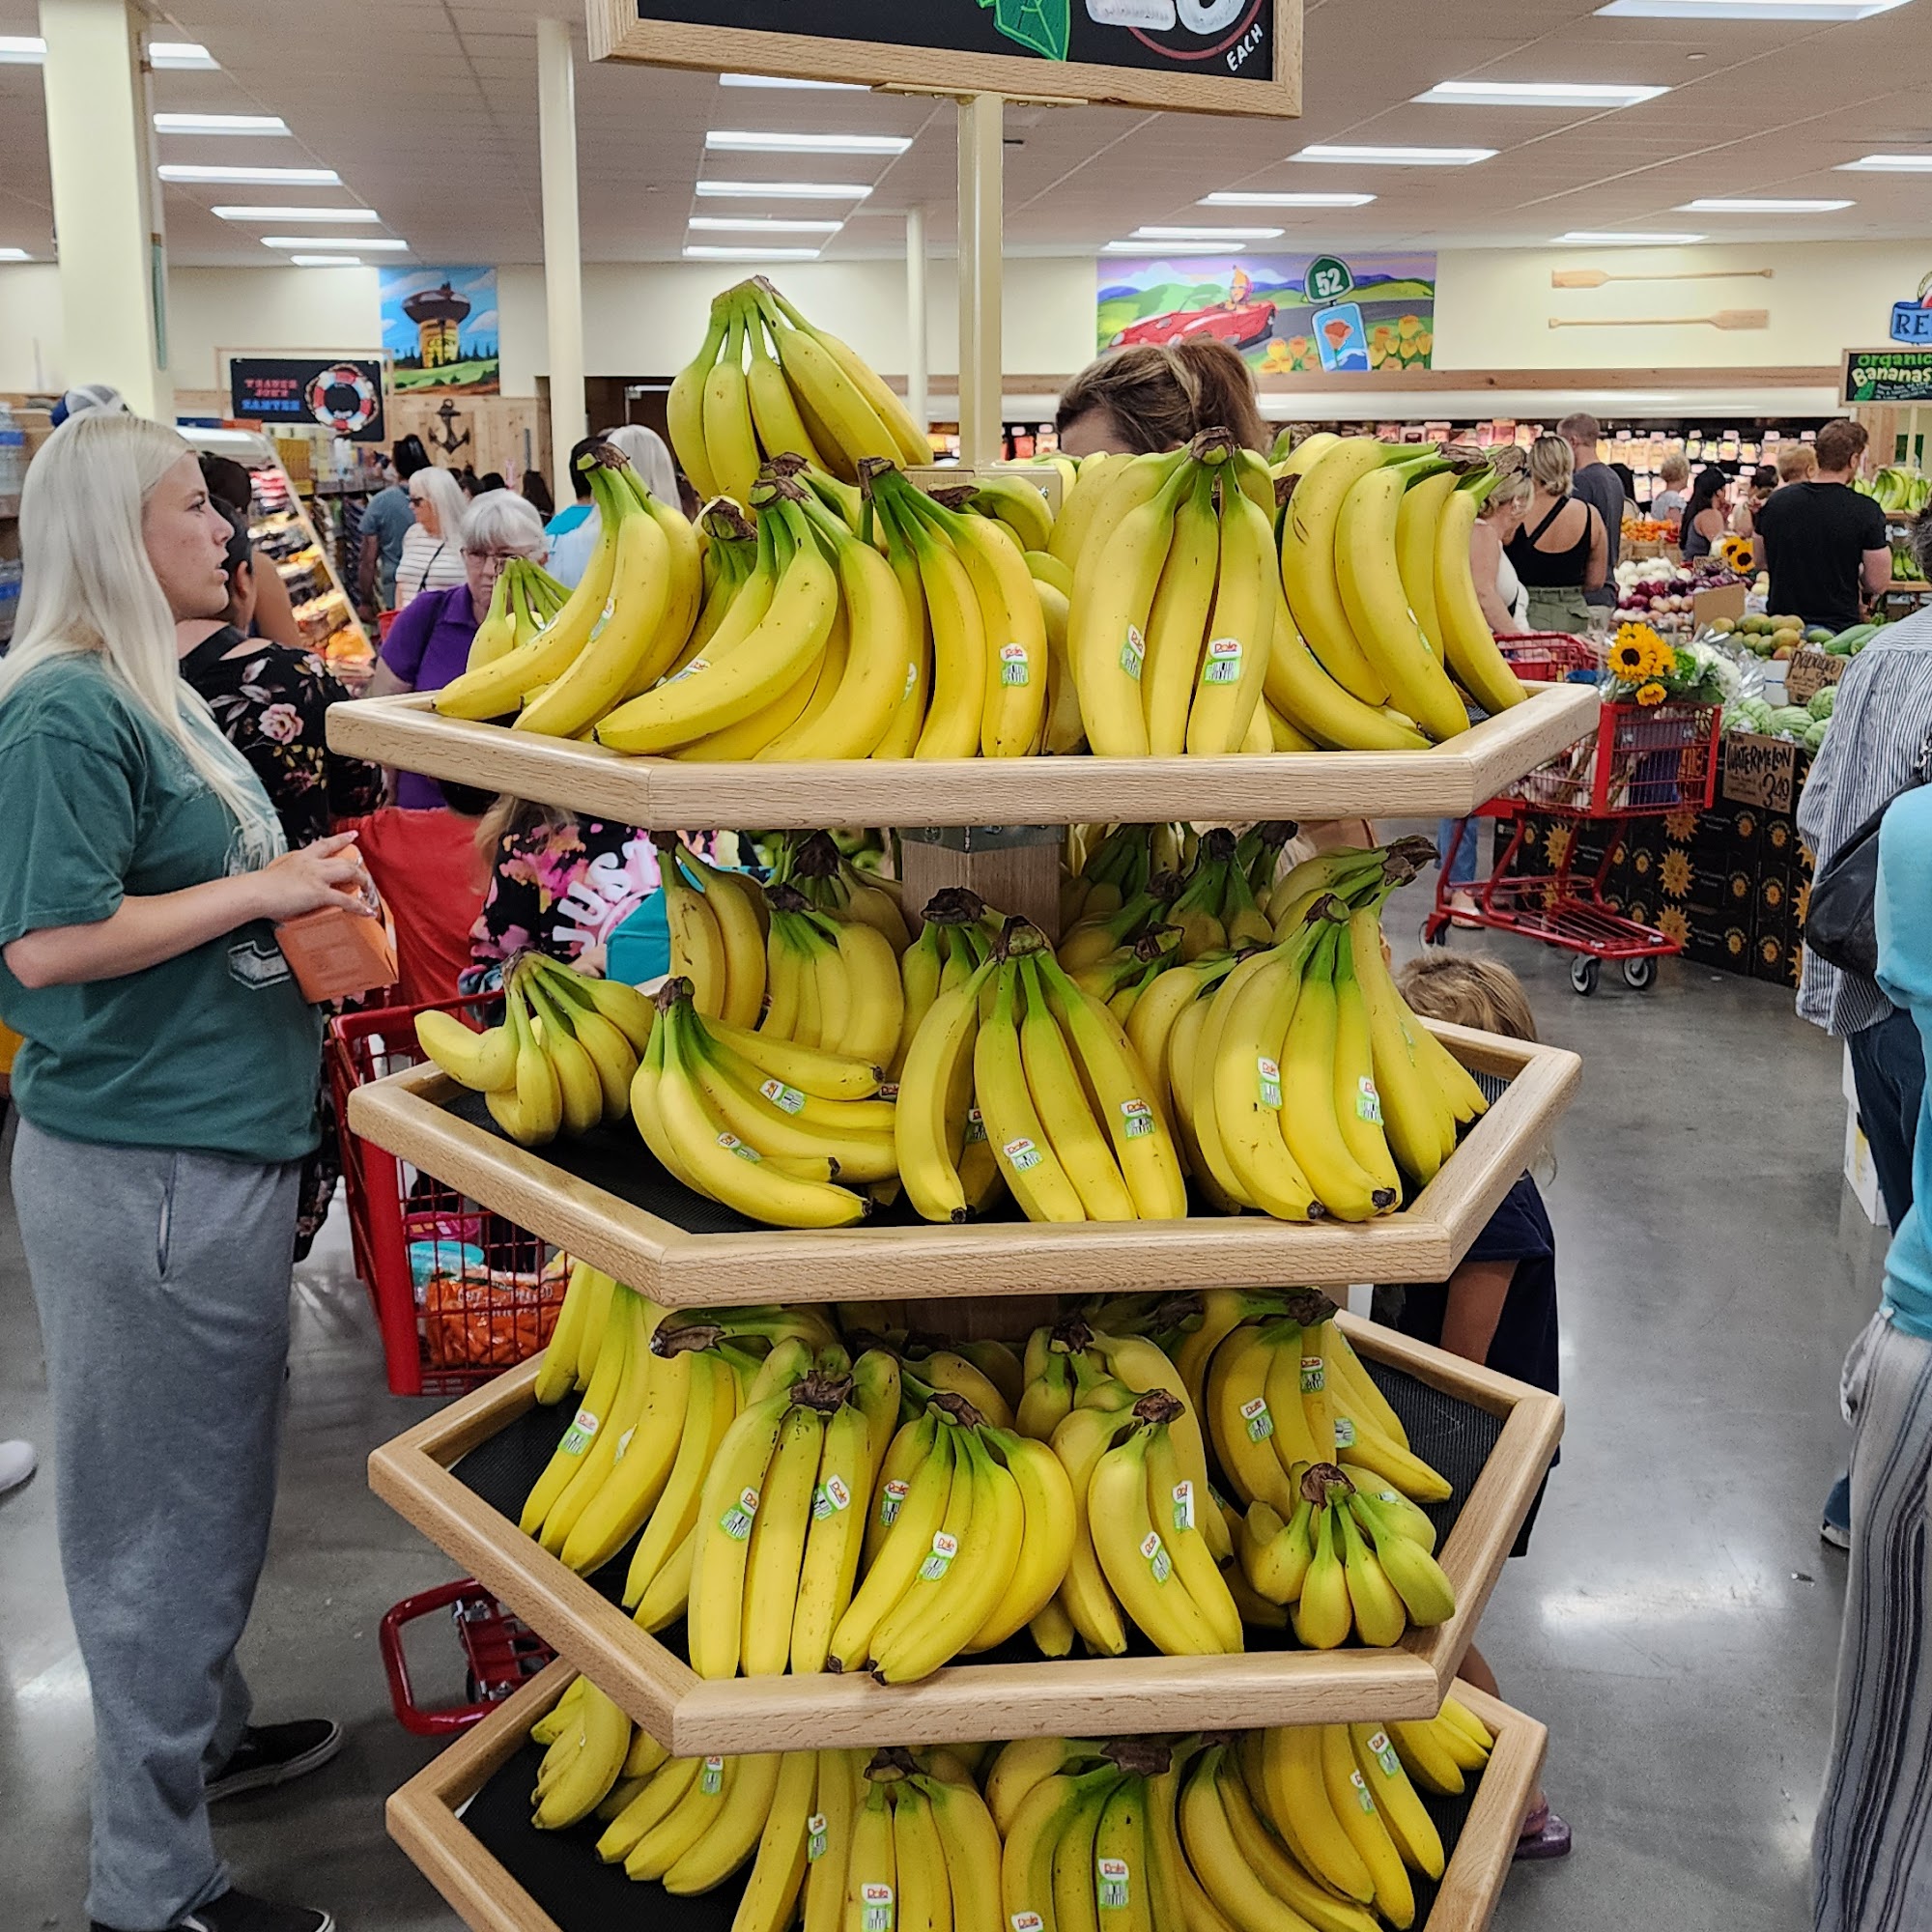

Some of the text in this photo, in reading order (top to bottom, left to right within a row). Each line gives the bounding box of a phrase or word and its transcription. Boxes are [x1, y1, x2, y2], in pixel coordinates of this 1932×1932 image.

[1226, 23, 1264, 71] EACH
[1315, 268, 1344, 297] 52
[1851, 367, 1932, 387] Bananas
[1214, 642, 1237, 654] Dole
[1726, 745, 1792, 774] WATERMELON
[1263, 1062, 1276, 1077] Dole
[1126, 1101, 1147, 1113] Dole
[1008, 1140, 1030, 1153] Dole
[1301, 1358, 1321, 1368] Dole
[1245, 1400, 1263, 1416] Dole
[579, 1414, 594, 1431] Dole
[829, 1481, 847, 1504] Dole
[888, 1482, 908, 1494] Dole
[936, 1537, 955, 1552] Dole
[1103, 1862, 1125, 1875] Dole
[867, 1888, 889, 1900] Dole
[1017, 1915, 1039, 1928] Dole
